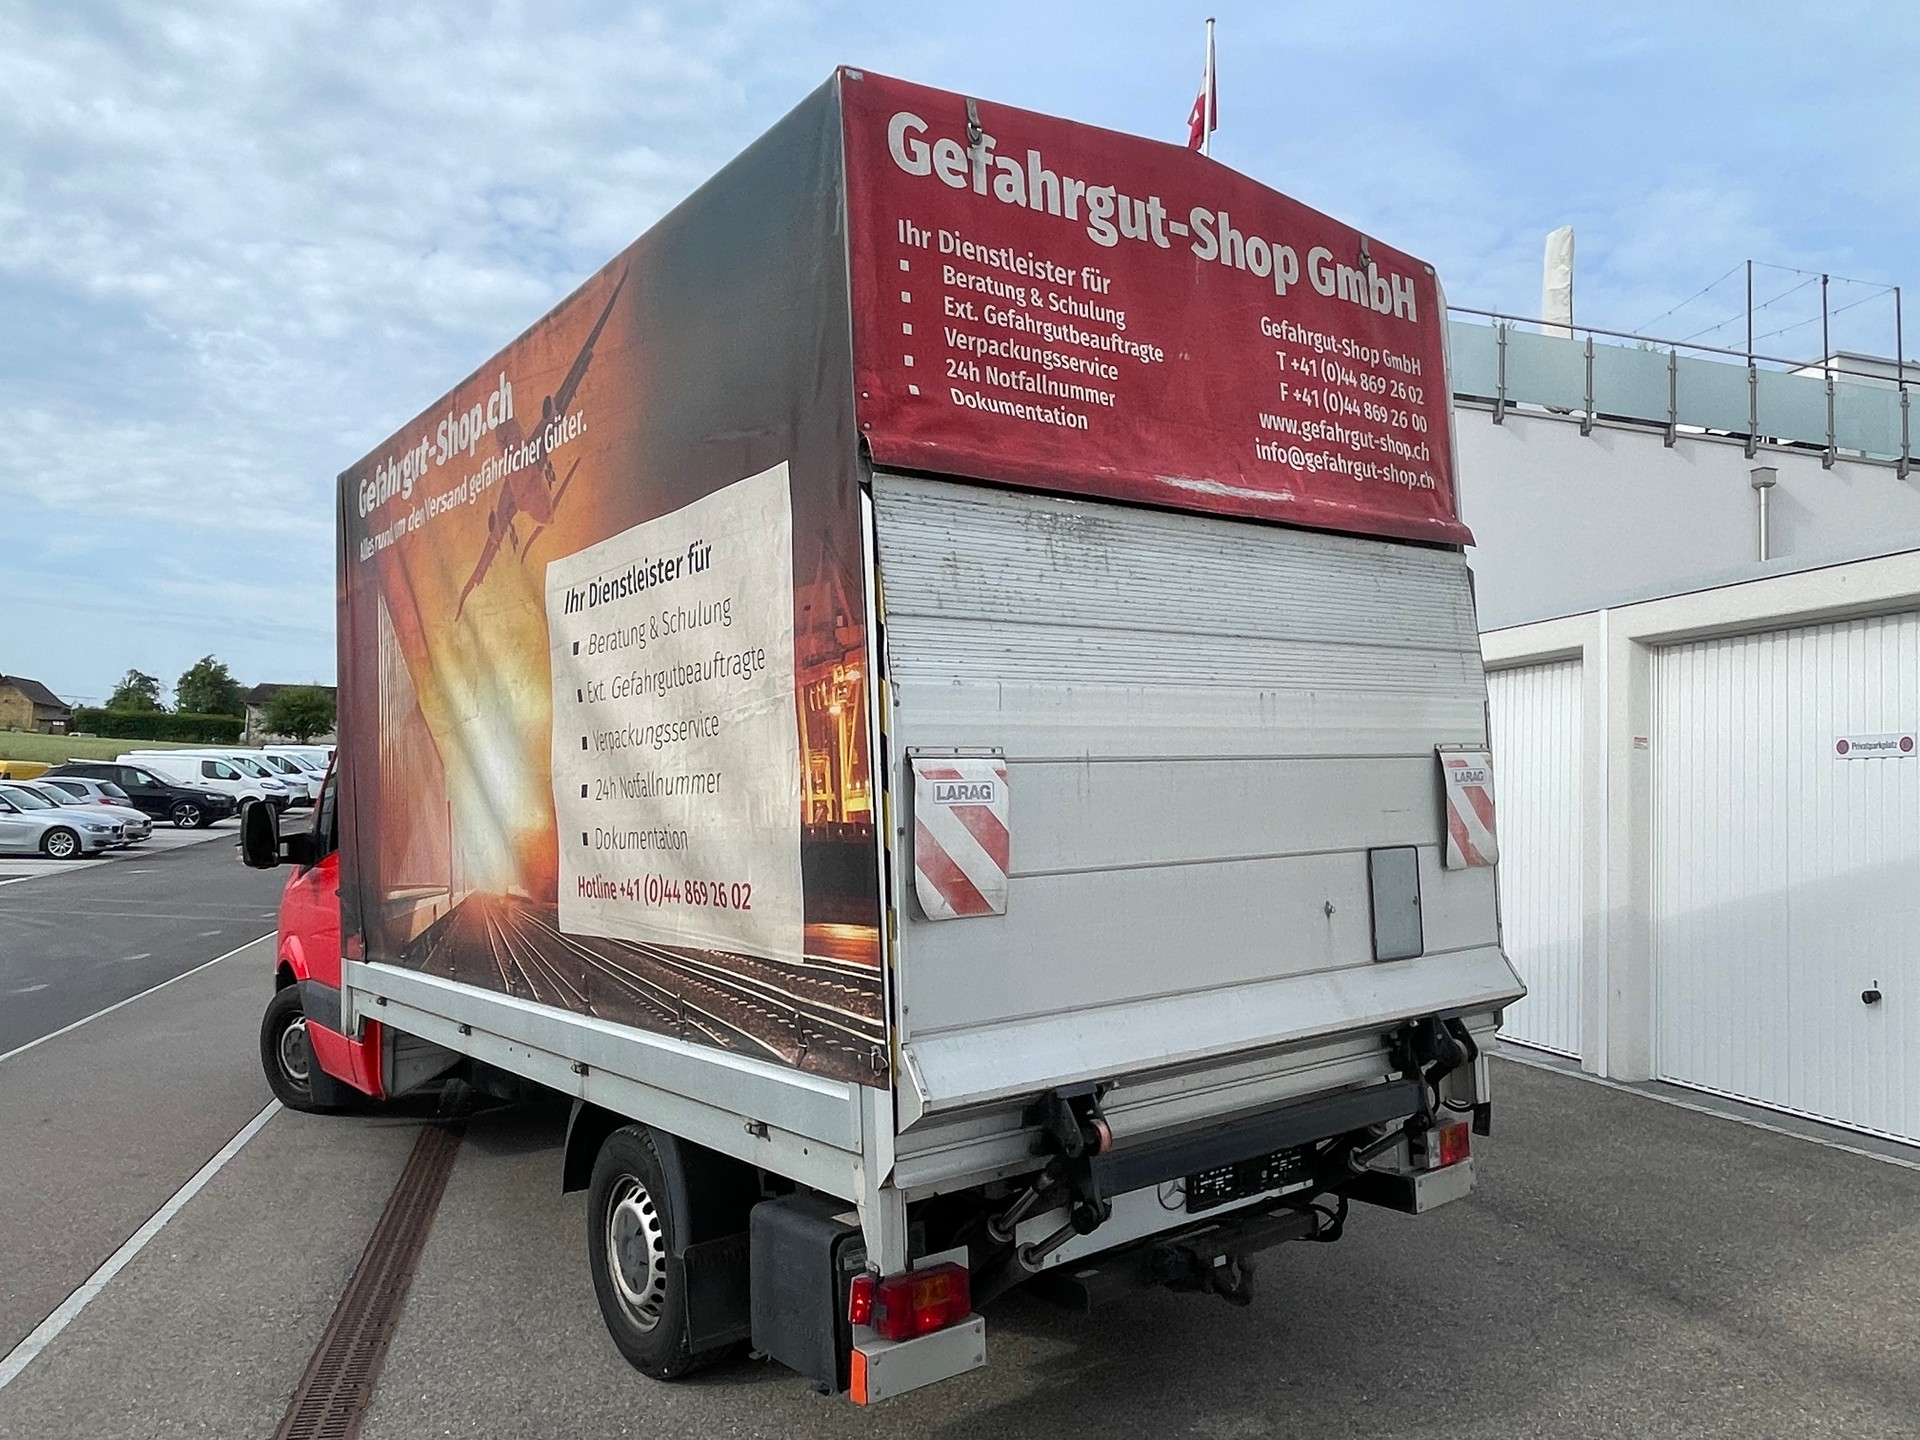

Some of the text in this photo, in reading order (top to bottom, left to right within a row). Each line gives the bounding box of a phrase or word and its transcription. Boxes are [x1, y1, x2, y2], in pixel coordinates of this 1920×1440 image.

[887, 111, 1417, 322] Gefahrgut-Shop GmbH
[898, 219, 1110, 294] Ihr Dienstleister für
[943, 265, 1126, 330] Beratung & Schulung
[944, 296, 1164, 364] Ext. Gefahrgutbeauftragte
[944, 327, 1119, 381] Verpackungsservice
[1260, 316, 1422, 376] Gefahrgut-Shop GmbH
[946, 359, 1116, 407] 24h Notfallnummer
[1276, 351, 1424, 405] T +41 (0)44 869 26 02
[950, 387, 1089, 430] Dokumentation
[1280, 382, 1427, 433] F +41 (0)44 869 26 00
[358, 371, 514, 518] Gefahrgut-Shop.ch
[1255, 437, 1435, 490] info@gefahrgut-shop.ch
[1259, 413, 1430, 462] www.gefahrgut-shop.ch
[408, 506, 426, 532] den
[424, 476, 467, 520] Versand
[469, 436, 542, 505] gefährlicher
[545, 409, 587, 454] Güter.
[564, 539, 712, 615] Ihr Dienstleister für
[588, 597, 732, 655] Beratung & Schulung
[587, 646, 766, 704] Ext. Gefahrgutbeauftragte
[592, 711, 720, 755] Verpackungsservice
[595, 771, 721, 801] 24h Notfallnummer
[936, 784, 992, 801] LARAG
[1454, 771, 1484, 783] LARAG
[595, 824, 688, 851] Dokumentation
[578, 873, 752, 910] Hotline +41 (0)44 869 26 02
